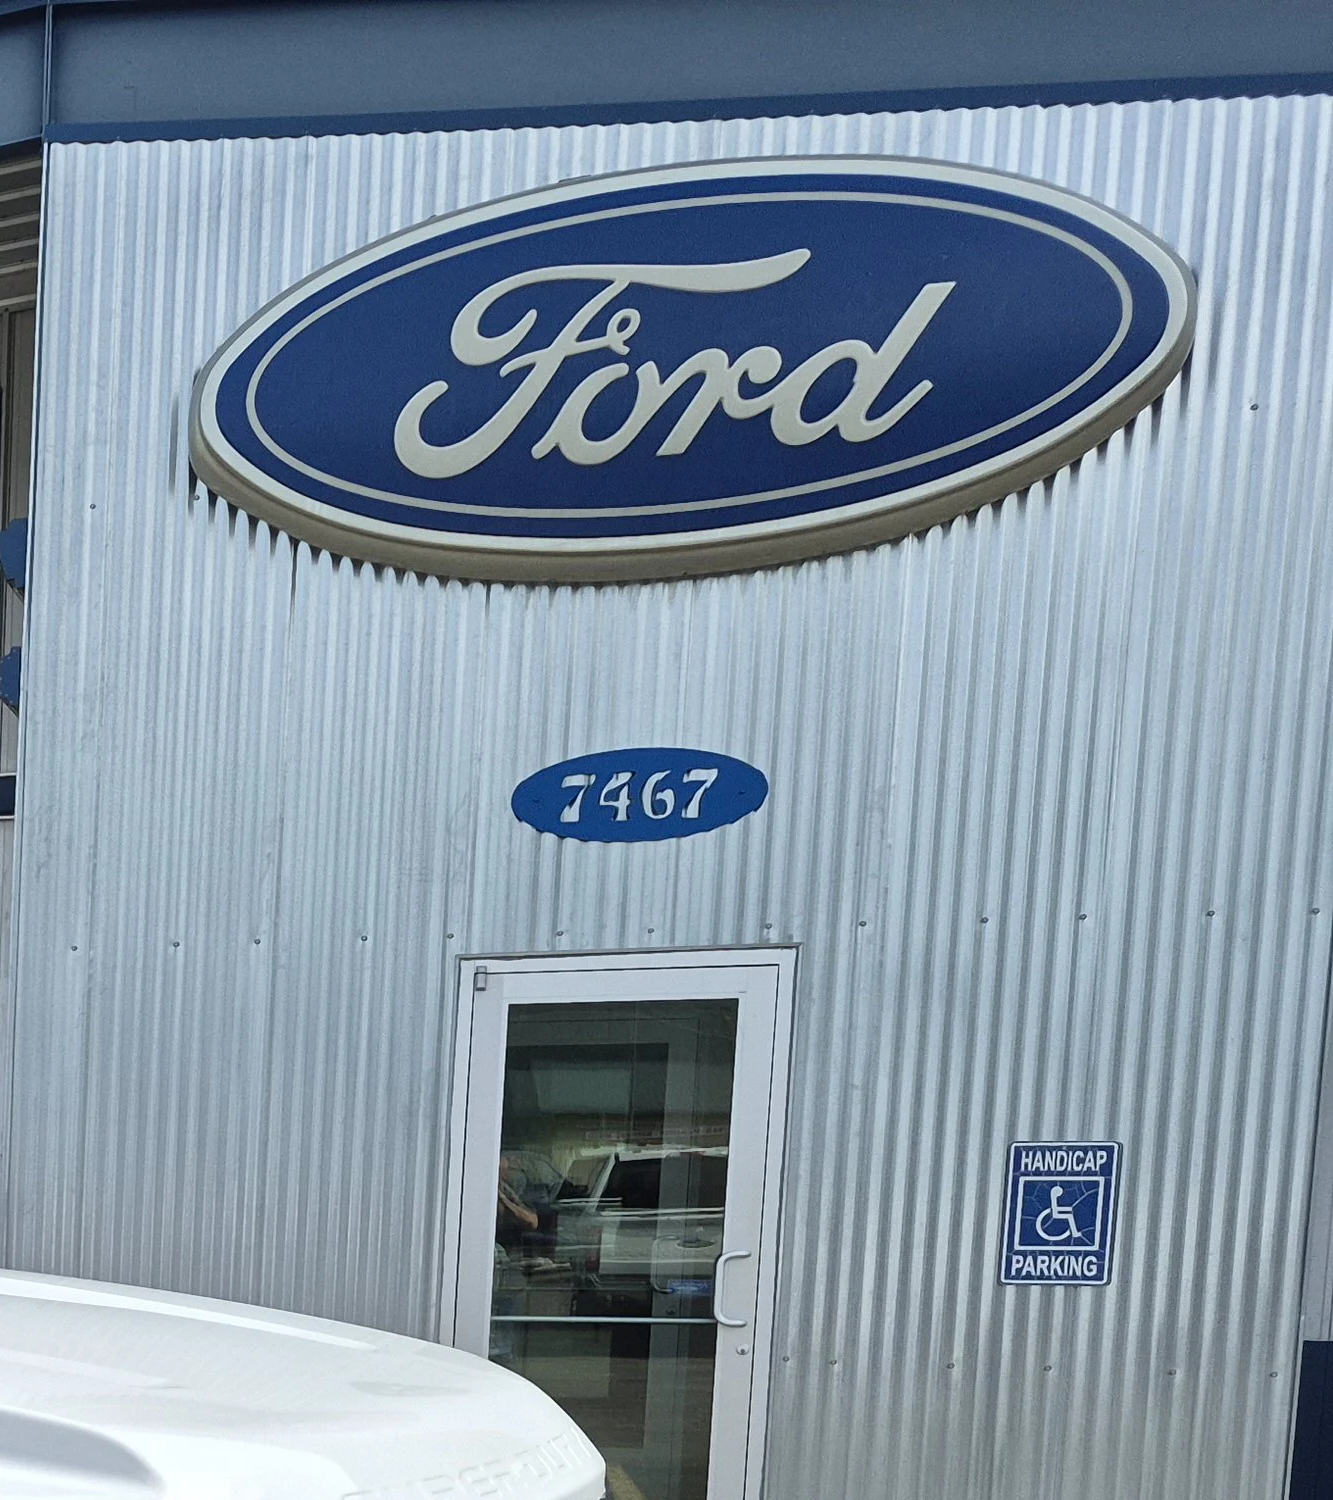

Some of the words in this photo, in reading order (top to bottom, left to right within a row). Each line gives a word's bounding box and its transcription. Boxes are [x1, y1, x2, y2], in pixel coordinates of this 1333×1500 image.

[395, 248, 956, 480] Ford
[560, 768, 720, 823] 7467
[1020, 1150, 1108, 1172] HANDICAP
[1010, 1254, 1098, 1277] PARKING
